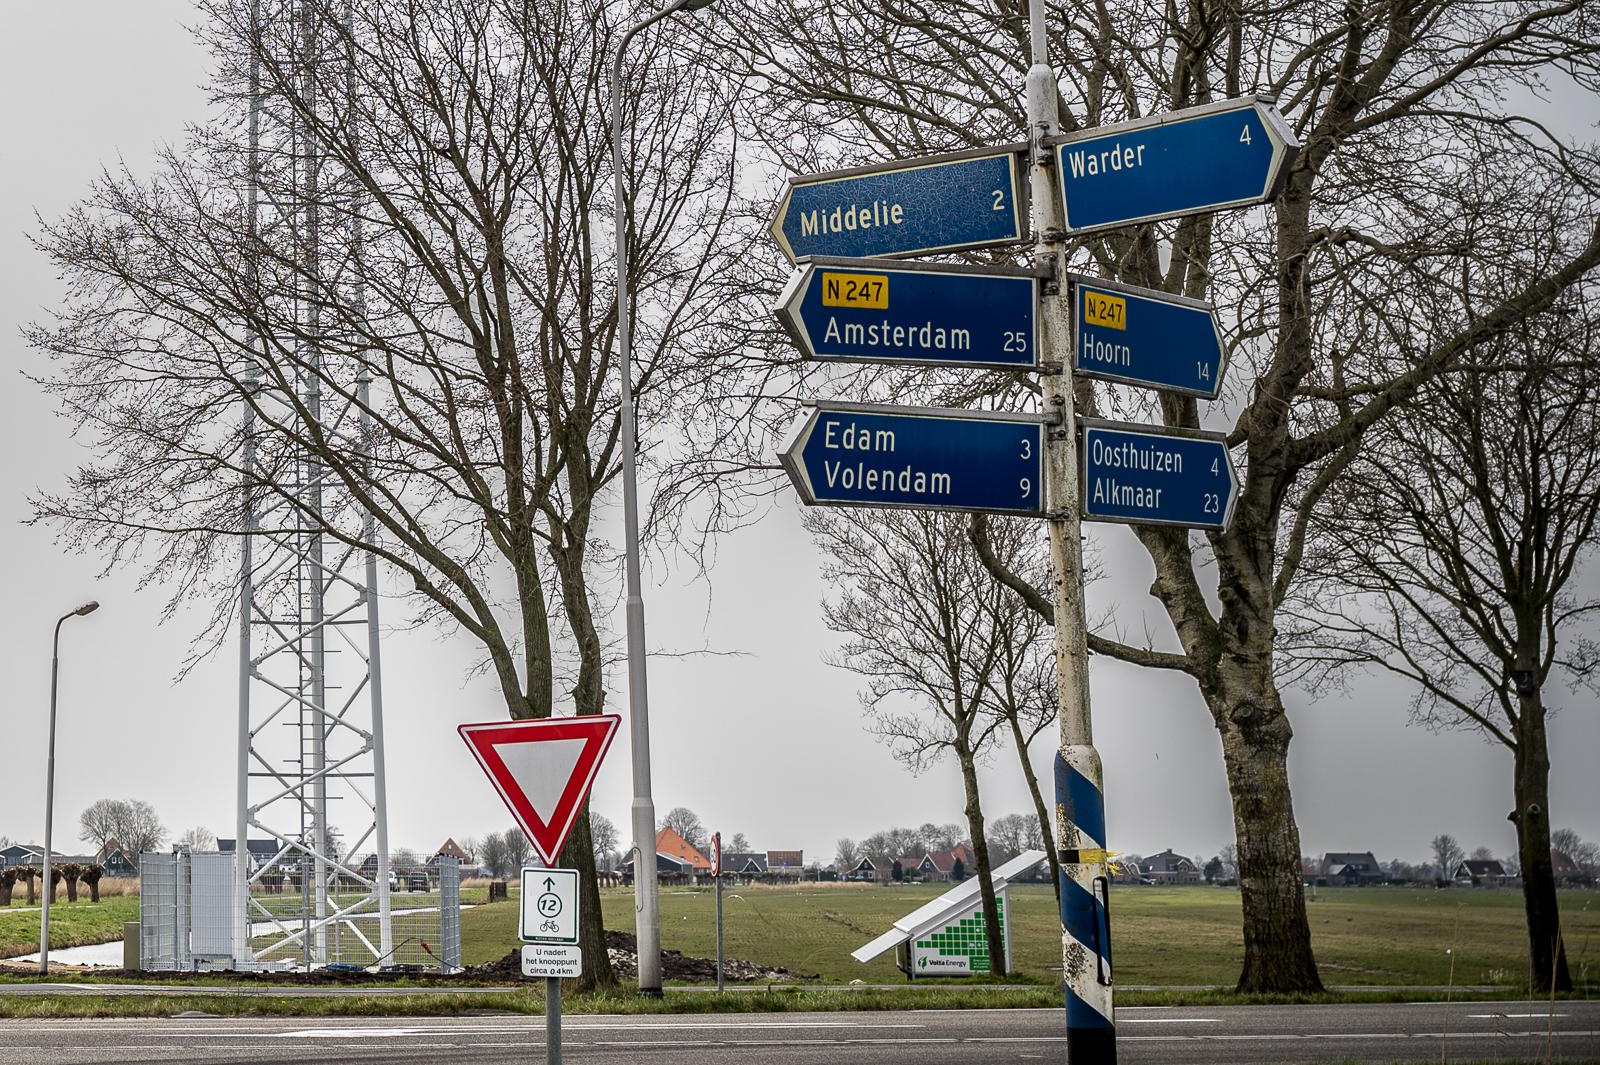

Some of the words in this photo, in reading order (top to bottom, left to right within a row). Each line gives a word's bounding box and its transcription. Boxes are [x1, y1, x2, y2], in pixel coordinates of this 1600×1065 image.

[1068, 142, 1146, 179] Warder
[1239, 123, 1252, 146] 4
[799, 200, 904, 237] Middelie
[991, 189, 1005, 211] 2
[827, 279, 840, 300] N
[845, 280, 883, 302] 247
[1087, 298, 1096, 318] N
[1099, 300, 1123, 323] 247
[823, 315, 971, 350] Amsterdam
[1003, 331, 1027, 353] 25
[1083, 332, 1131, 367] Hoorn
[1196, 360, 1209, 382] 14
[825, 420, 896, 453] Edam
[1020, 439, 1031, 460] 3
[1092, 438, 1183, 473] Oosthuizen
[1210, 457, 1219, 477] 4
[824, 459, 951, 495] Volendam
[1019, 477, 1031, 499] 9
[1092, 477, 1163, 509] Alkmaar
[1203, 493, 1220, 514] 23
[541, 899, 557, 911] 12
[539, 958, 577, 966] knooppunt
[945, 959, 967, 967] Energy
